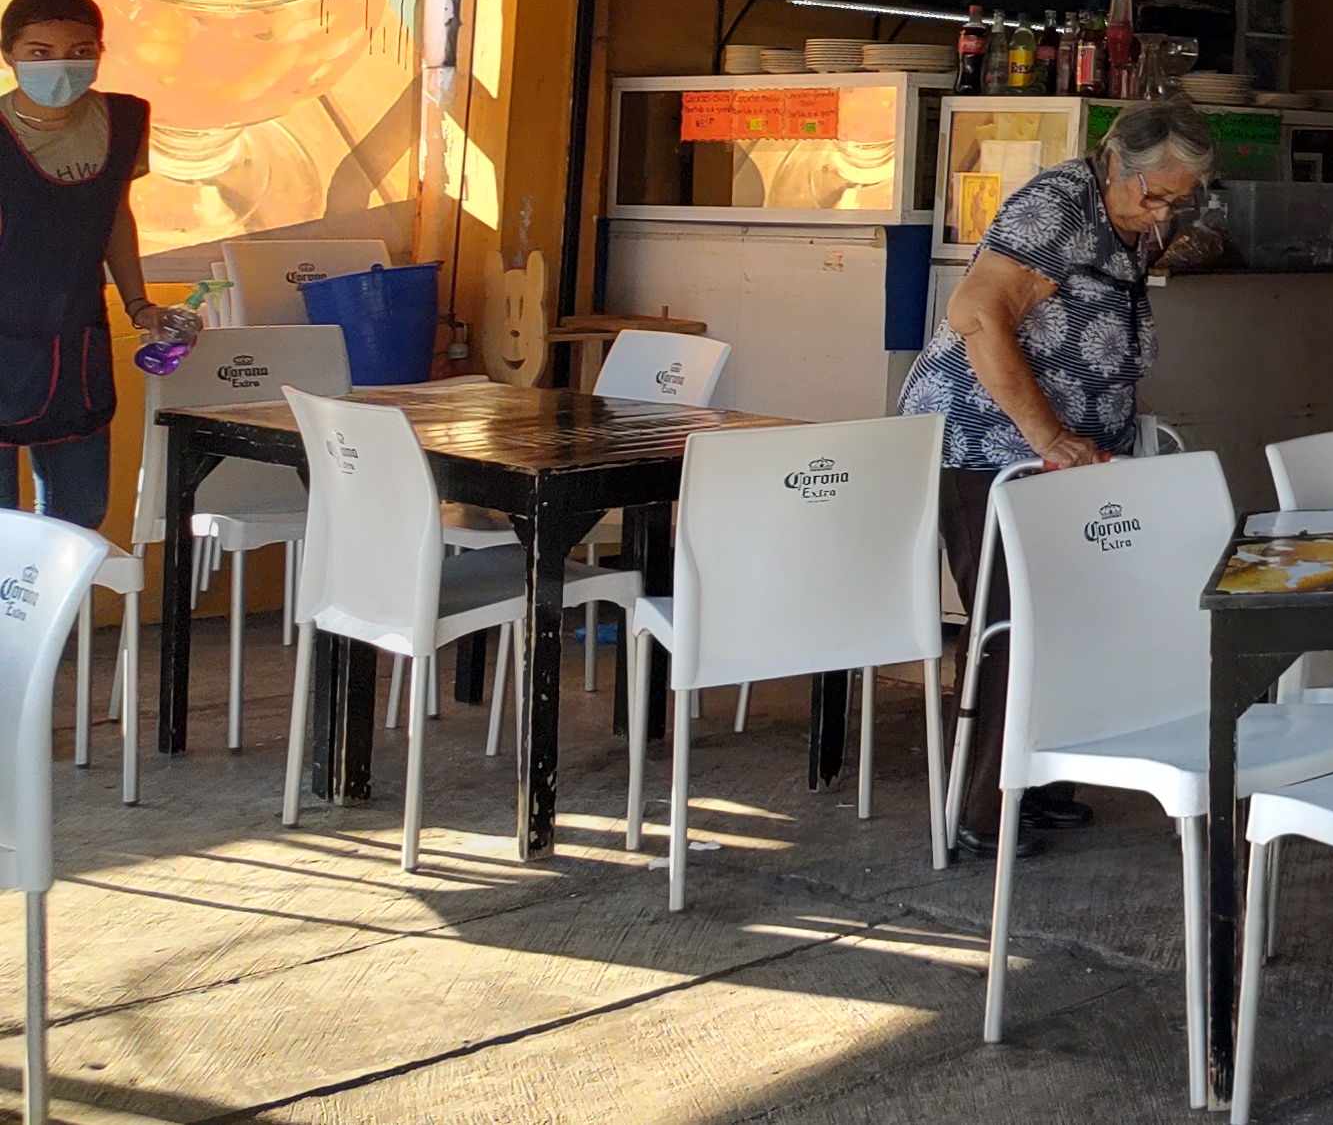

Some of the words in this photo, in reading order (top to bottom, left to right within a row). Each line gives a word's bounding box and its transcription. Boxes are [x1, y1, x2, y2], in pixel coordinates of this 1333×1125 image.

[217, 366, 269, 381] Corona
[232, 378, 260, 388] Extra
[784, 471, 849, 491] Corona
[801, 487, 836, 498] Extra
[1084, 518, 1141, 543] Corona
[1101, 538, 1132, 551] Extra
